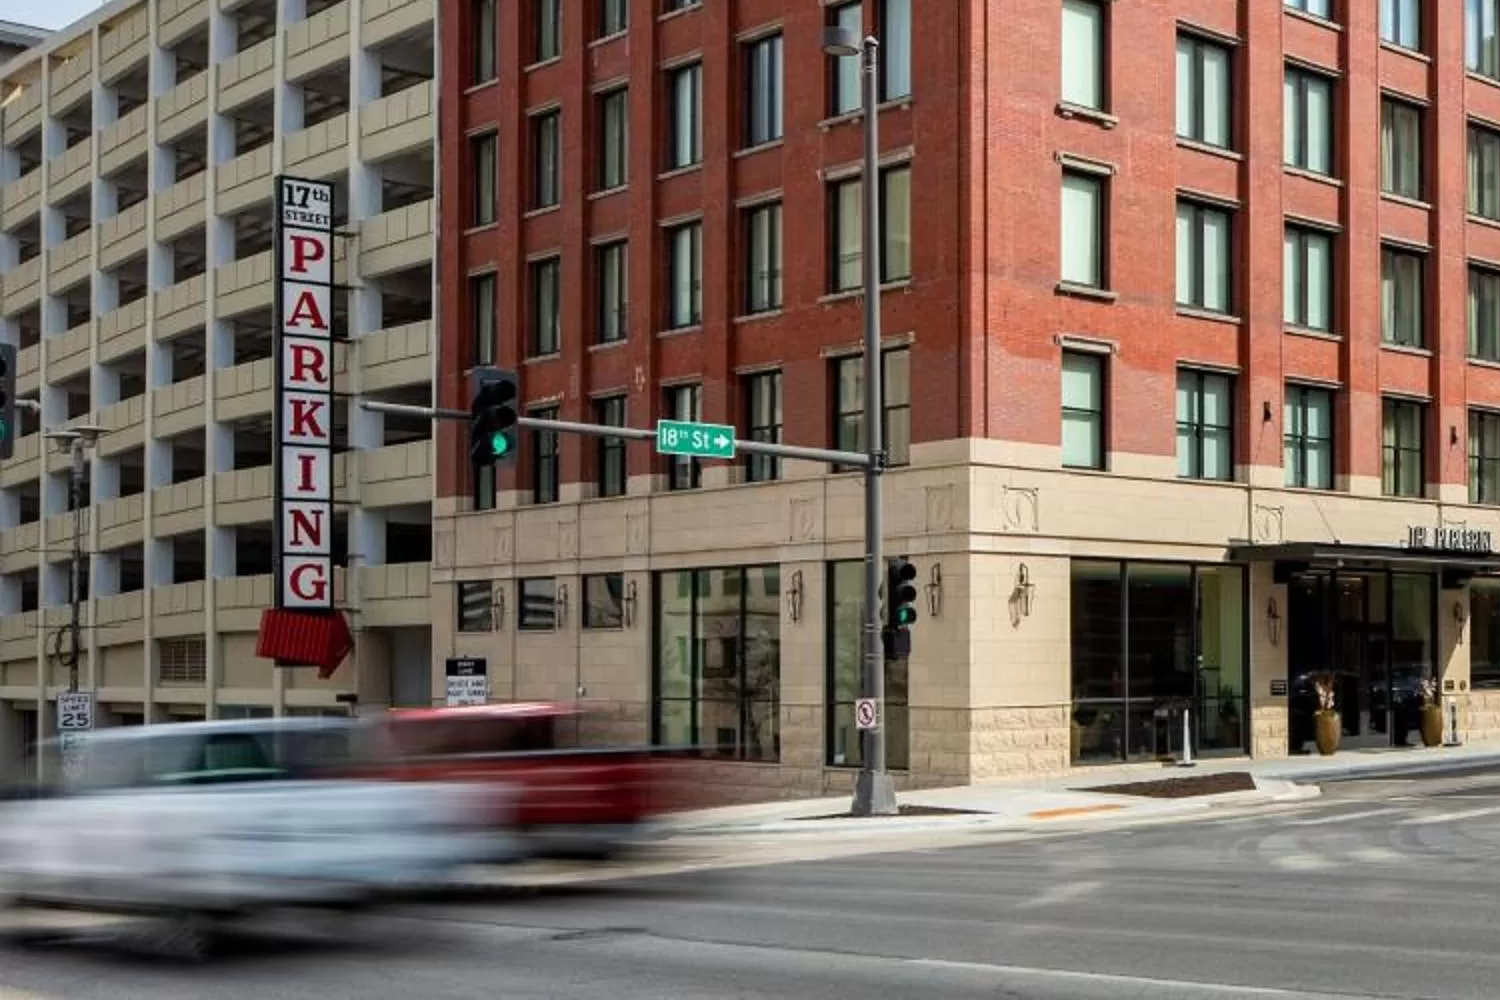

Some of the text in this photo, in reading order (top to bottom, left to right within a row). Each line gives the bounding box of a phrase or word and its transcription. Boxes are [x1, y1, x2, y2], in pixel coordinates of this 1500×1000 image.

[284, 183, 329, 209] 17th
[286, 210, 330, 225] STREET
[286, 235, 329, 601] PARKING
[691, 430, 710, 450] St
[60, 695, 89, 703] SPEED
[63, 703, 86, 711] LIMIT
[62, 713, 89, 727] 25
